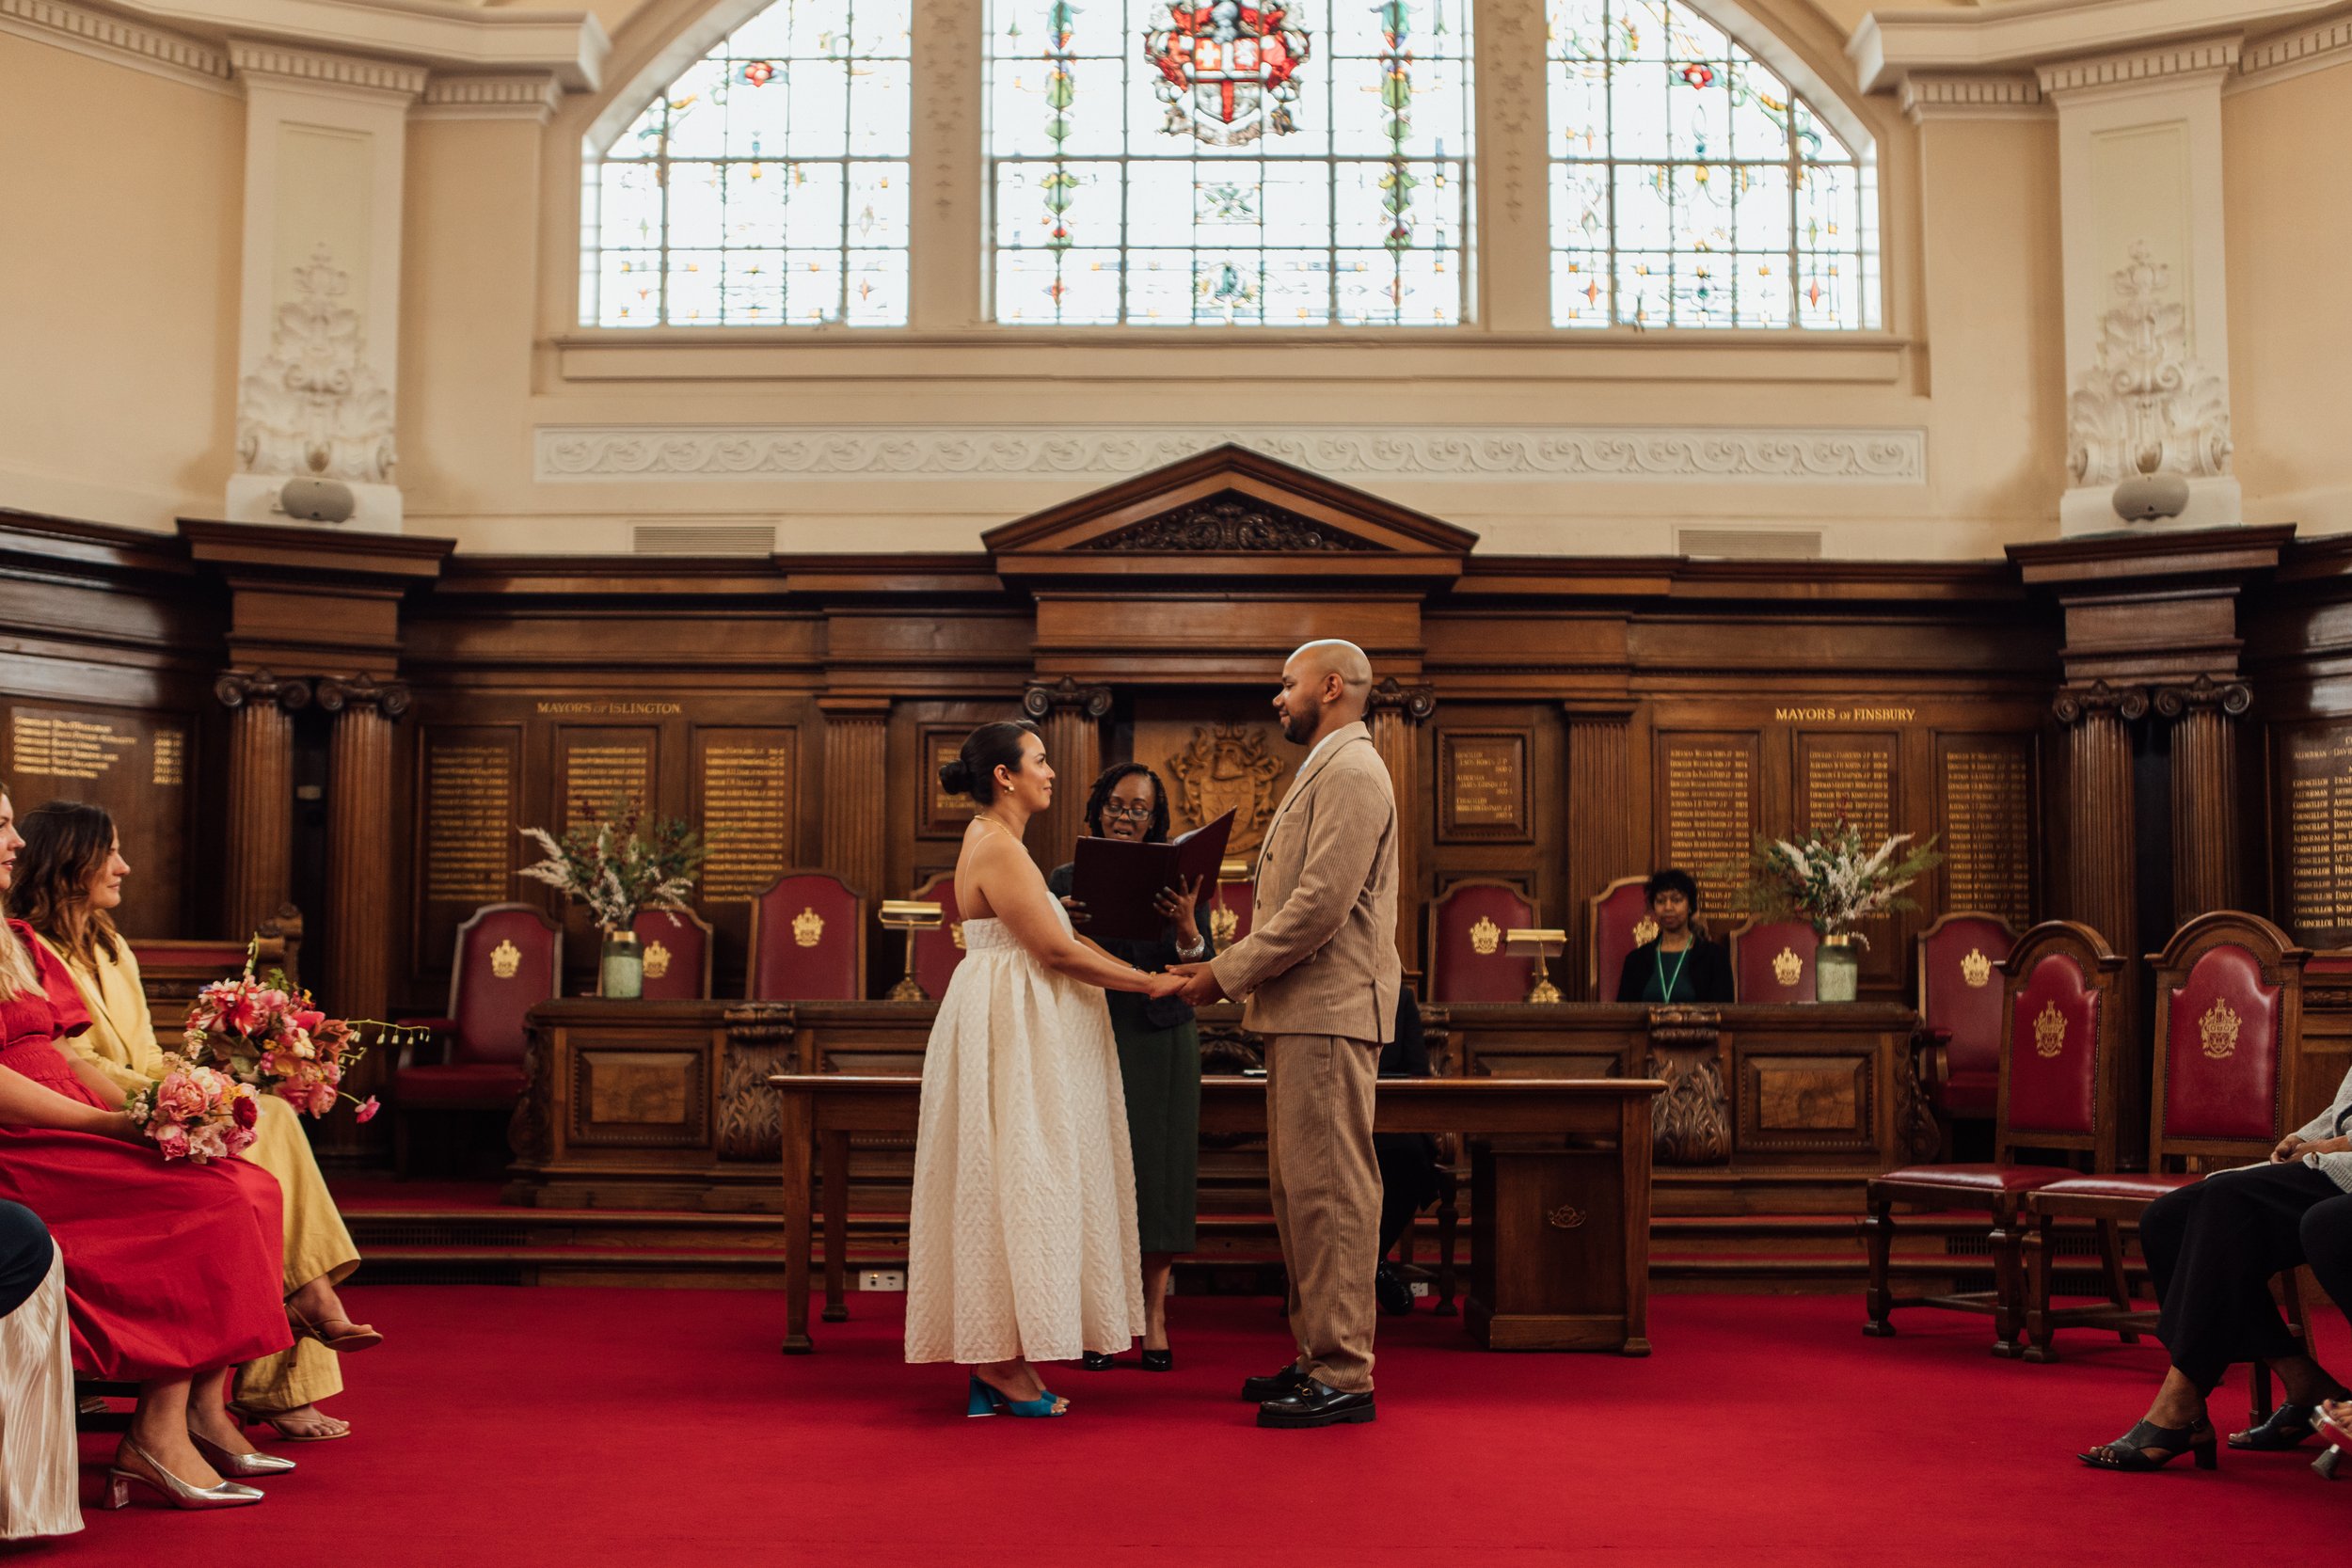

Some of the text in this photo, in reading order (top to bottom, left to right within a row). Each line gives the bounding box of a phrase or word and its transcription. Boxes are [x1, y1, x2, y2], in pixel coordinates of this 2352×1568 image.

[537, 702, 592, 714] MAYORS
[1775, 707, 1836, 721] MAYORS
[1840, 711, 1851, 721] OF
[2294, 918, 2333, 928] COUNCILLOR
